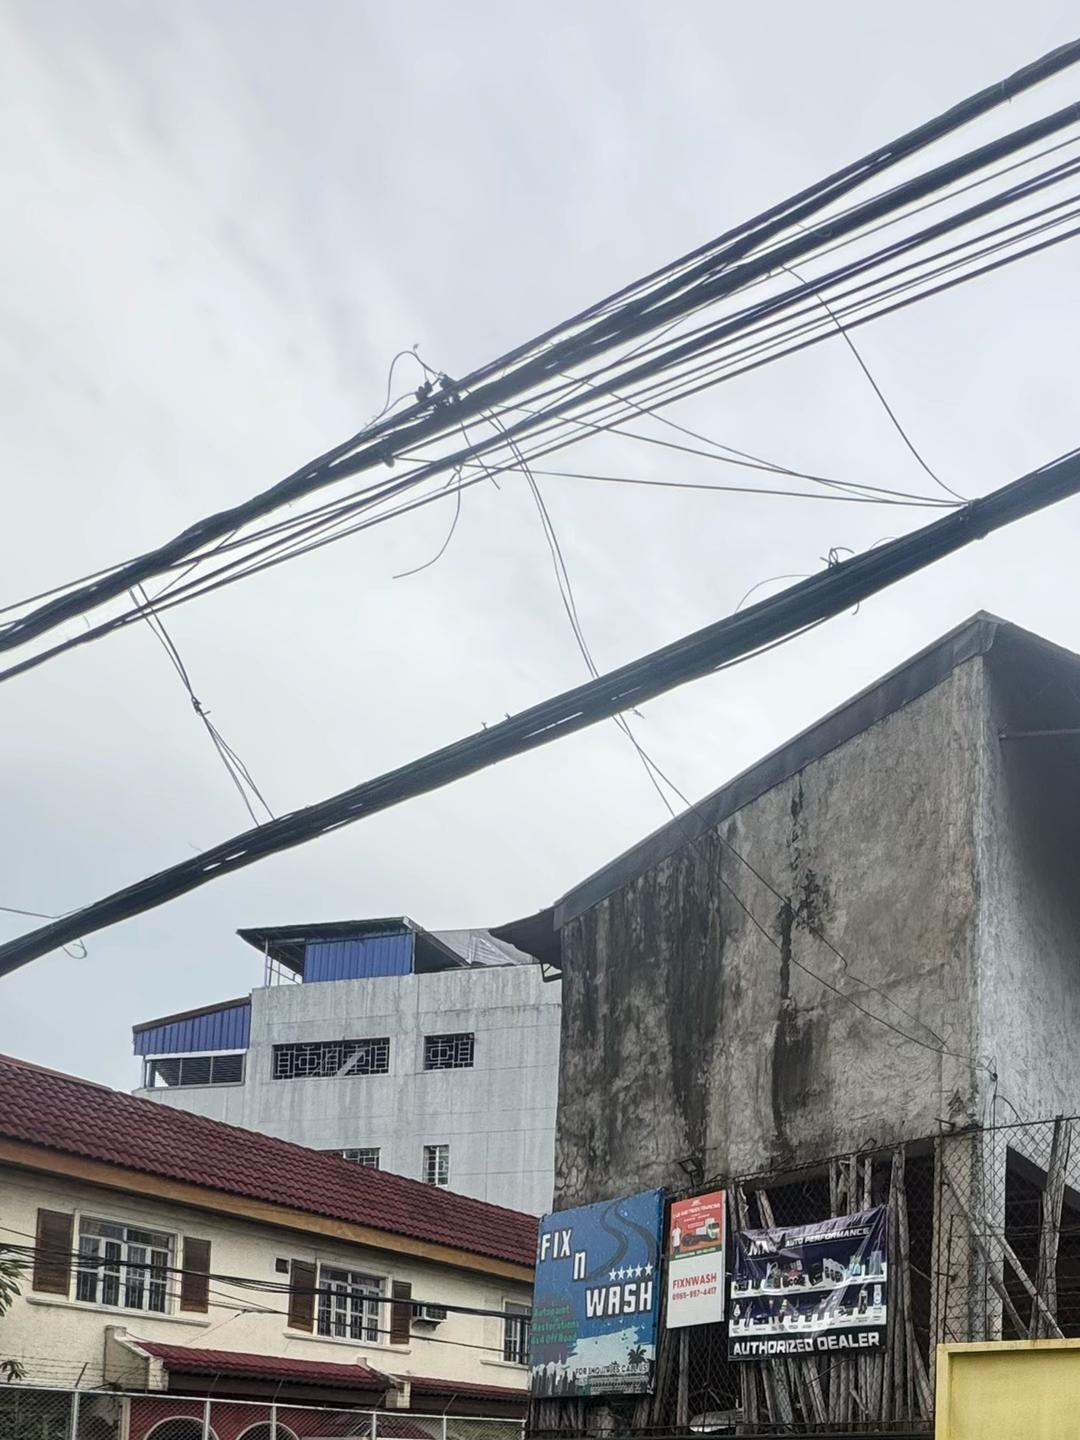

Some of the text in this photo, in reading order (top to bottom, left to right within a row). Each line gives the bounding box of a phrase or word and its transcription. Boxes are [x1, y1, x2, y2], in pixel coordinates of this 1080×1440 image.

[541, 1229, 572, 1261] FIX
[805, 1226, 871, 1244] PERFORMANCE
[673, 1272, 717, 1289] FIXNWASH
[586, 1281, 653, 1318] WASH
[733, 1331, 880, 1356] AUTHORIZED DEALER
